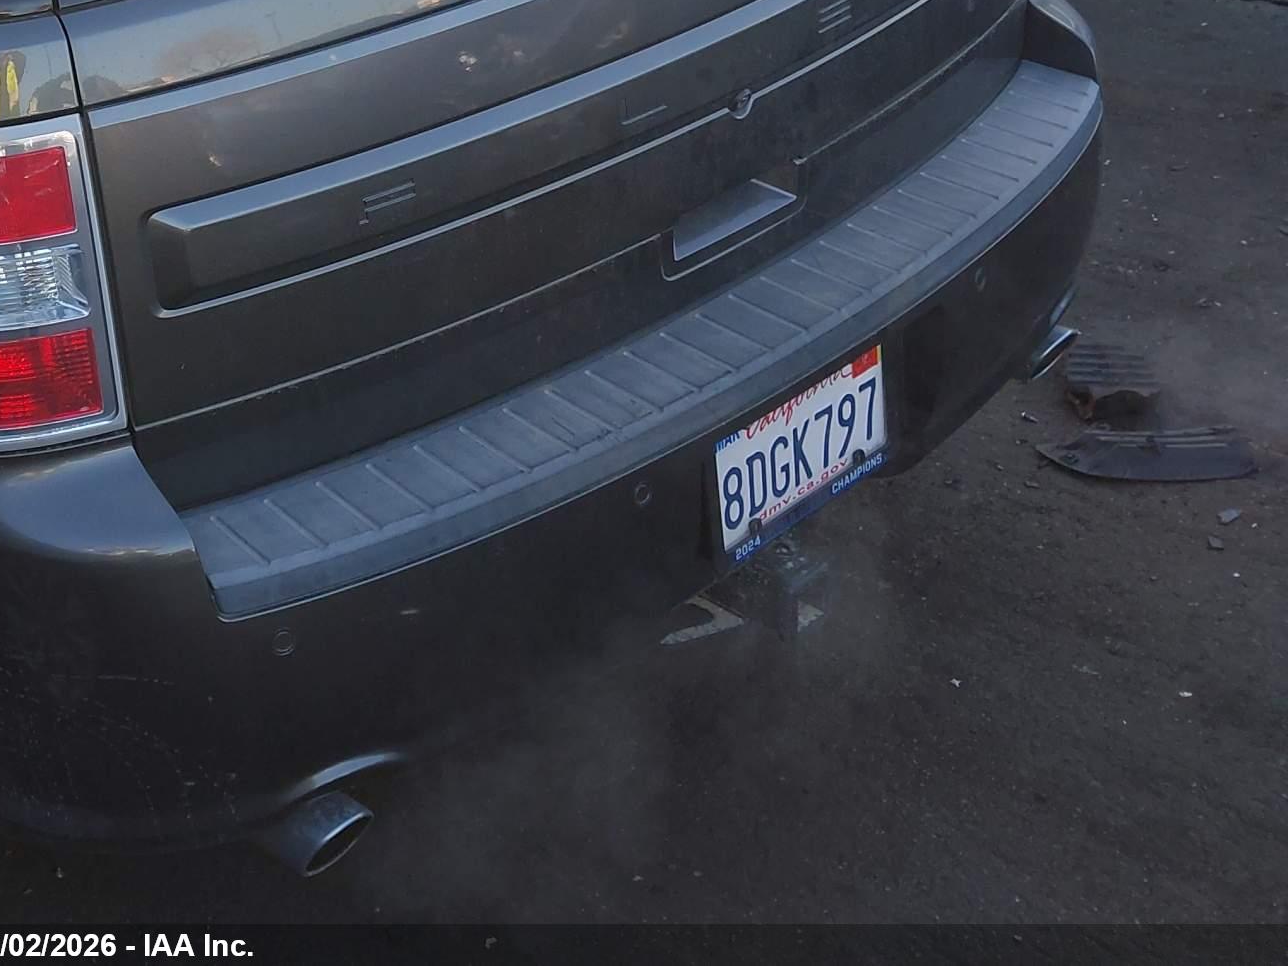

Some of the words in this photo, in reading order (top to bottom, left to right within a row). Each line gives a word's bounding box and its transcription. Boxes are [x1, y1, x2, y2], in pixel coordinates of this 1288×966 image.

[722, 376, 877, 531] 8DGK797
[735, 534, 761, 561] 2024
[831, 452, 883, 495] CHAMPIONS
[759, 457, 849, 521] dmv.ca.gov
